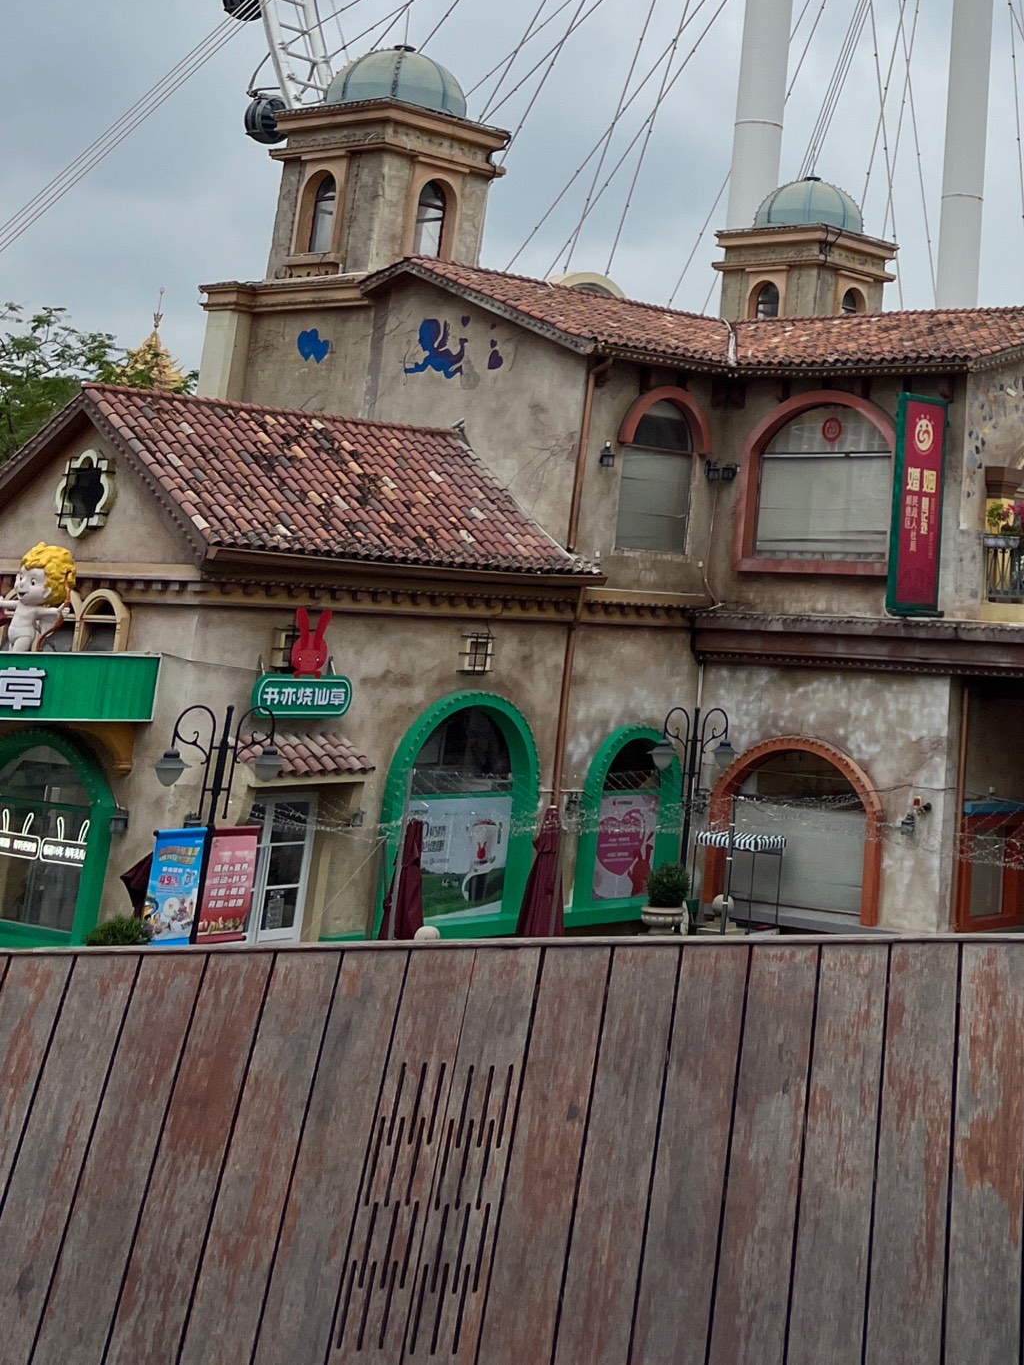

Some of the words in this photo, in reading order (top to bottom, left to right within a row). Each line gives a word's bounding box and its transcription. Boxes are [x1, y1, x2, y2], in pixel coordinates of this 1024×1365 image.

[0, 666, 46, 710] 草
[263, 687, 346, 706] 书亦烧仙草
